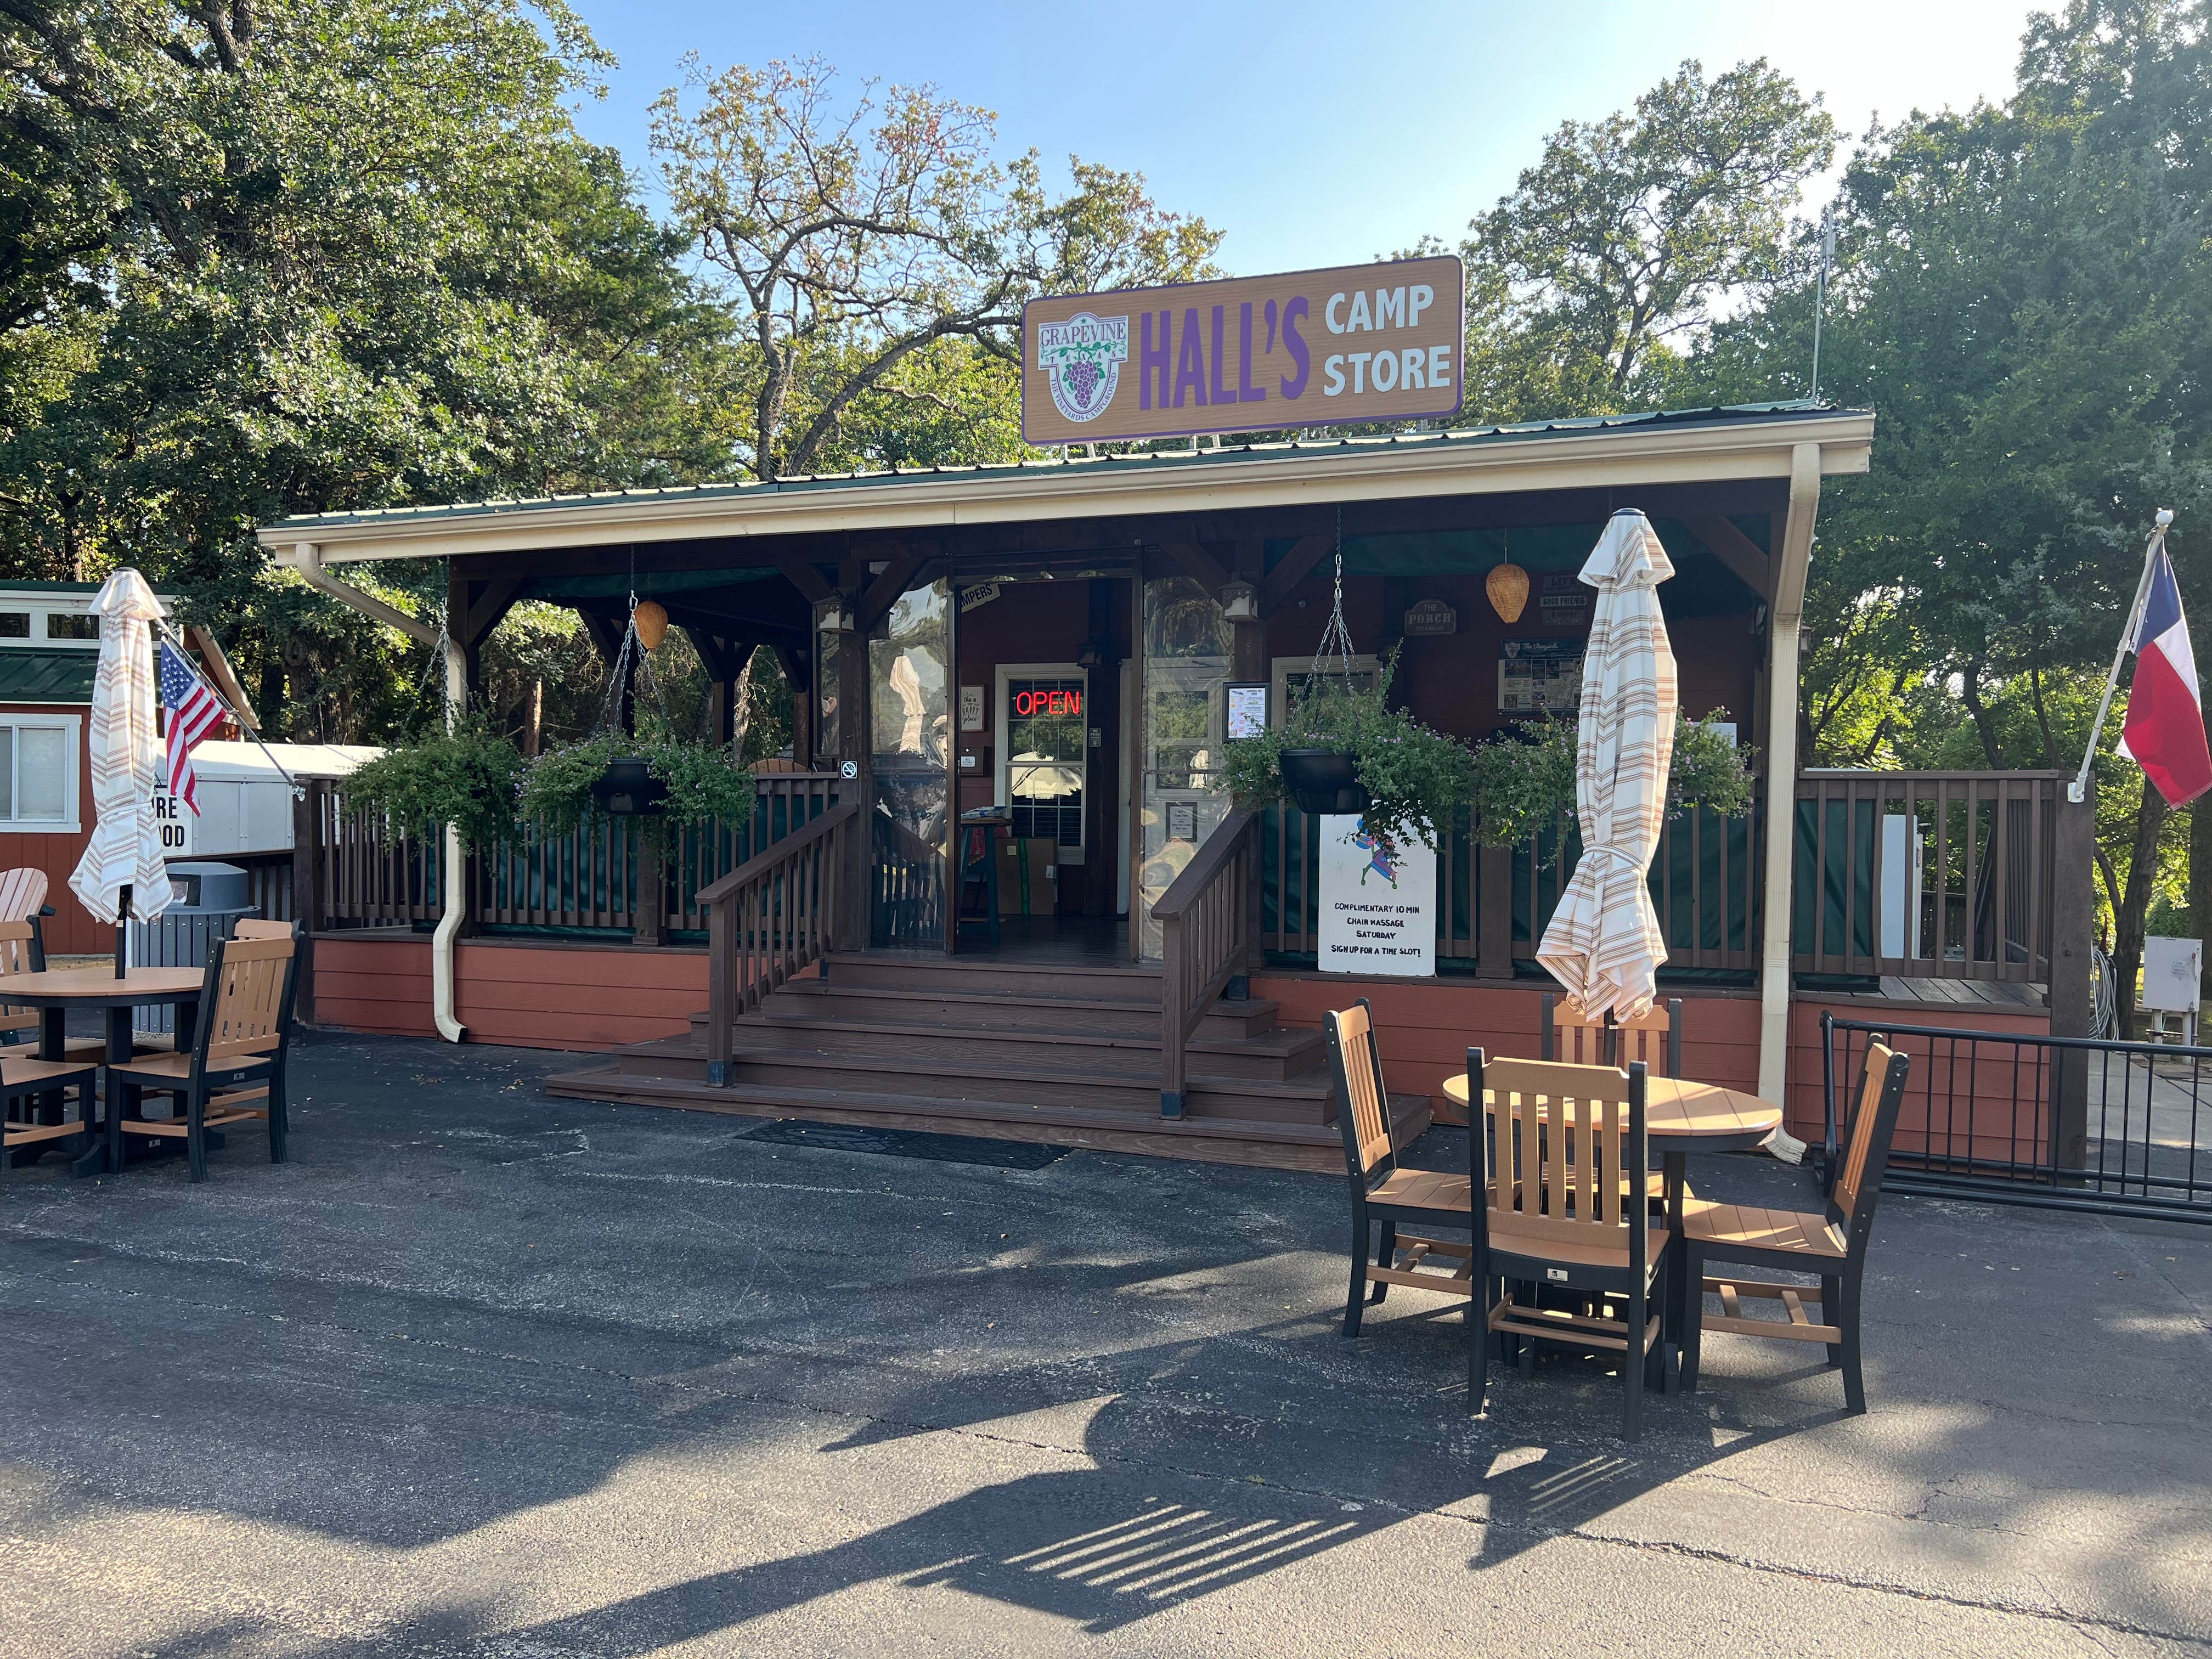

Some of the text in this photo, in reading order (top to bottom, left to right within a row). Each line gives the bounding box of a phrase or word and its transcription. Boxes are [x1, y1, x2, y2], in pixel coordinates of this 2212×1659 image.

[1325, 284, 1434, 335] CAMP
[1040, 322, 1126, 346] GRAPEVINE
[1050, 350, 1116, 364] TEXAS
[1139, 296, 1310, 410] HALL'S
[1324, 345, 1451, 397] STORE
[1054, 392, 1085, 421] VINEYARDS
[1086, 373, 1117, 420] CAMPGROUND
[961, 584, 992, 608] MPERS
[1423, 603, 1438, 612] THE
[1408, 613, 1452, 624] PORCH
[1017, 691, 1080, 714] OPEN
[962, 707, 979, 716] HAPPY
[963, 715, 977, 724] place
[159, 825, 184, 847] OD
[1335, 903, 1393, 912] COMPLIMENTARY
[1406, 906, 1420, 914] MIN
[1347, 917, 1404, 927] CHAIR MASSAGE
[1356, 930, 1396, 940] SATURDAY
[1331, 945, 1348, 953] SIGN
[1399, 947, 1421, 957] SLOT!
